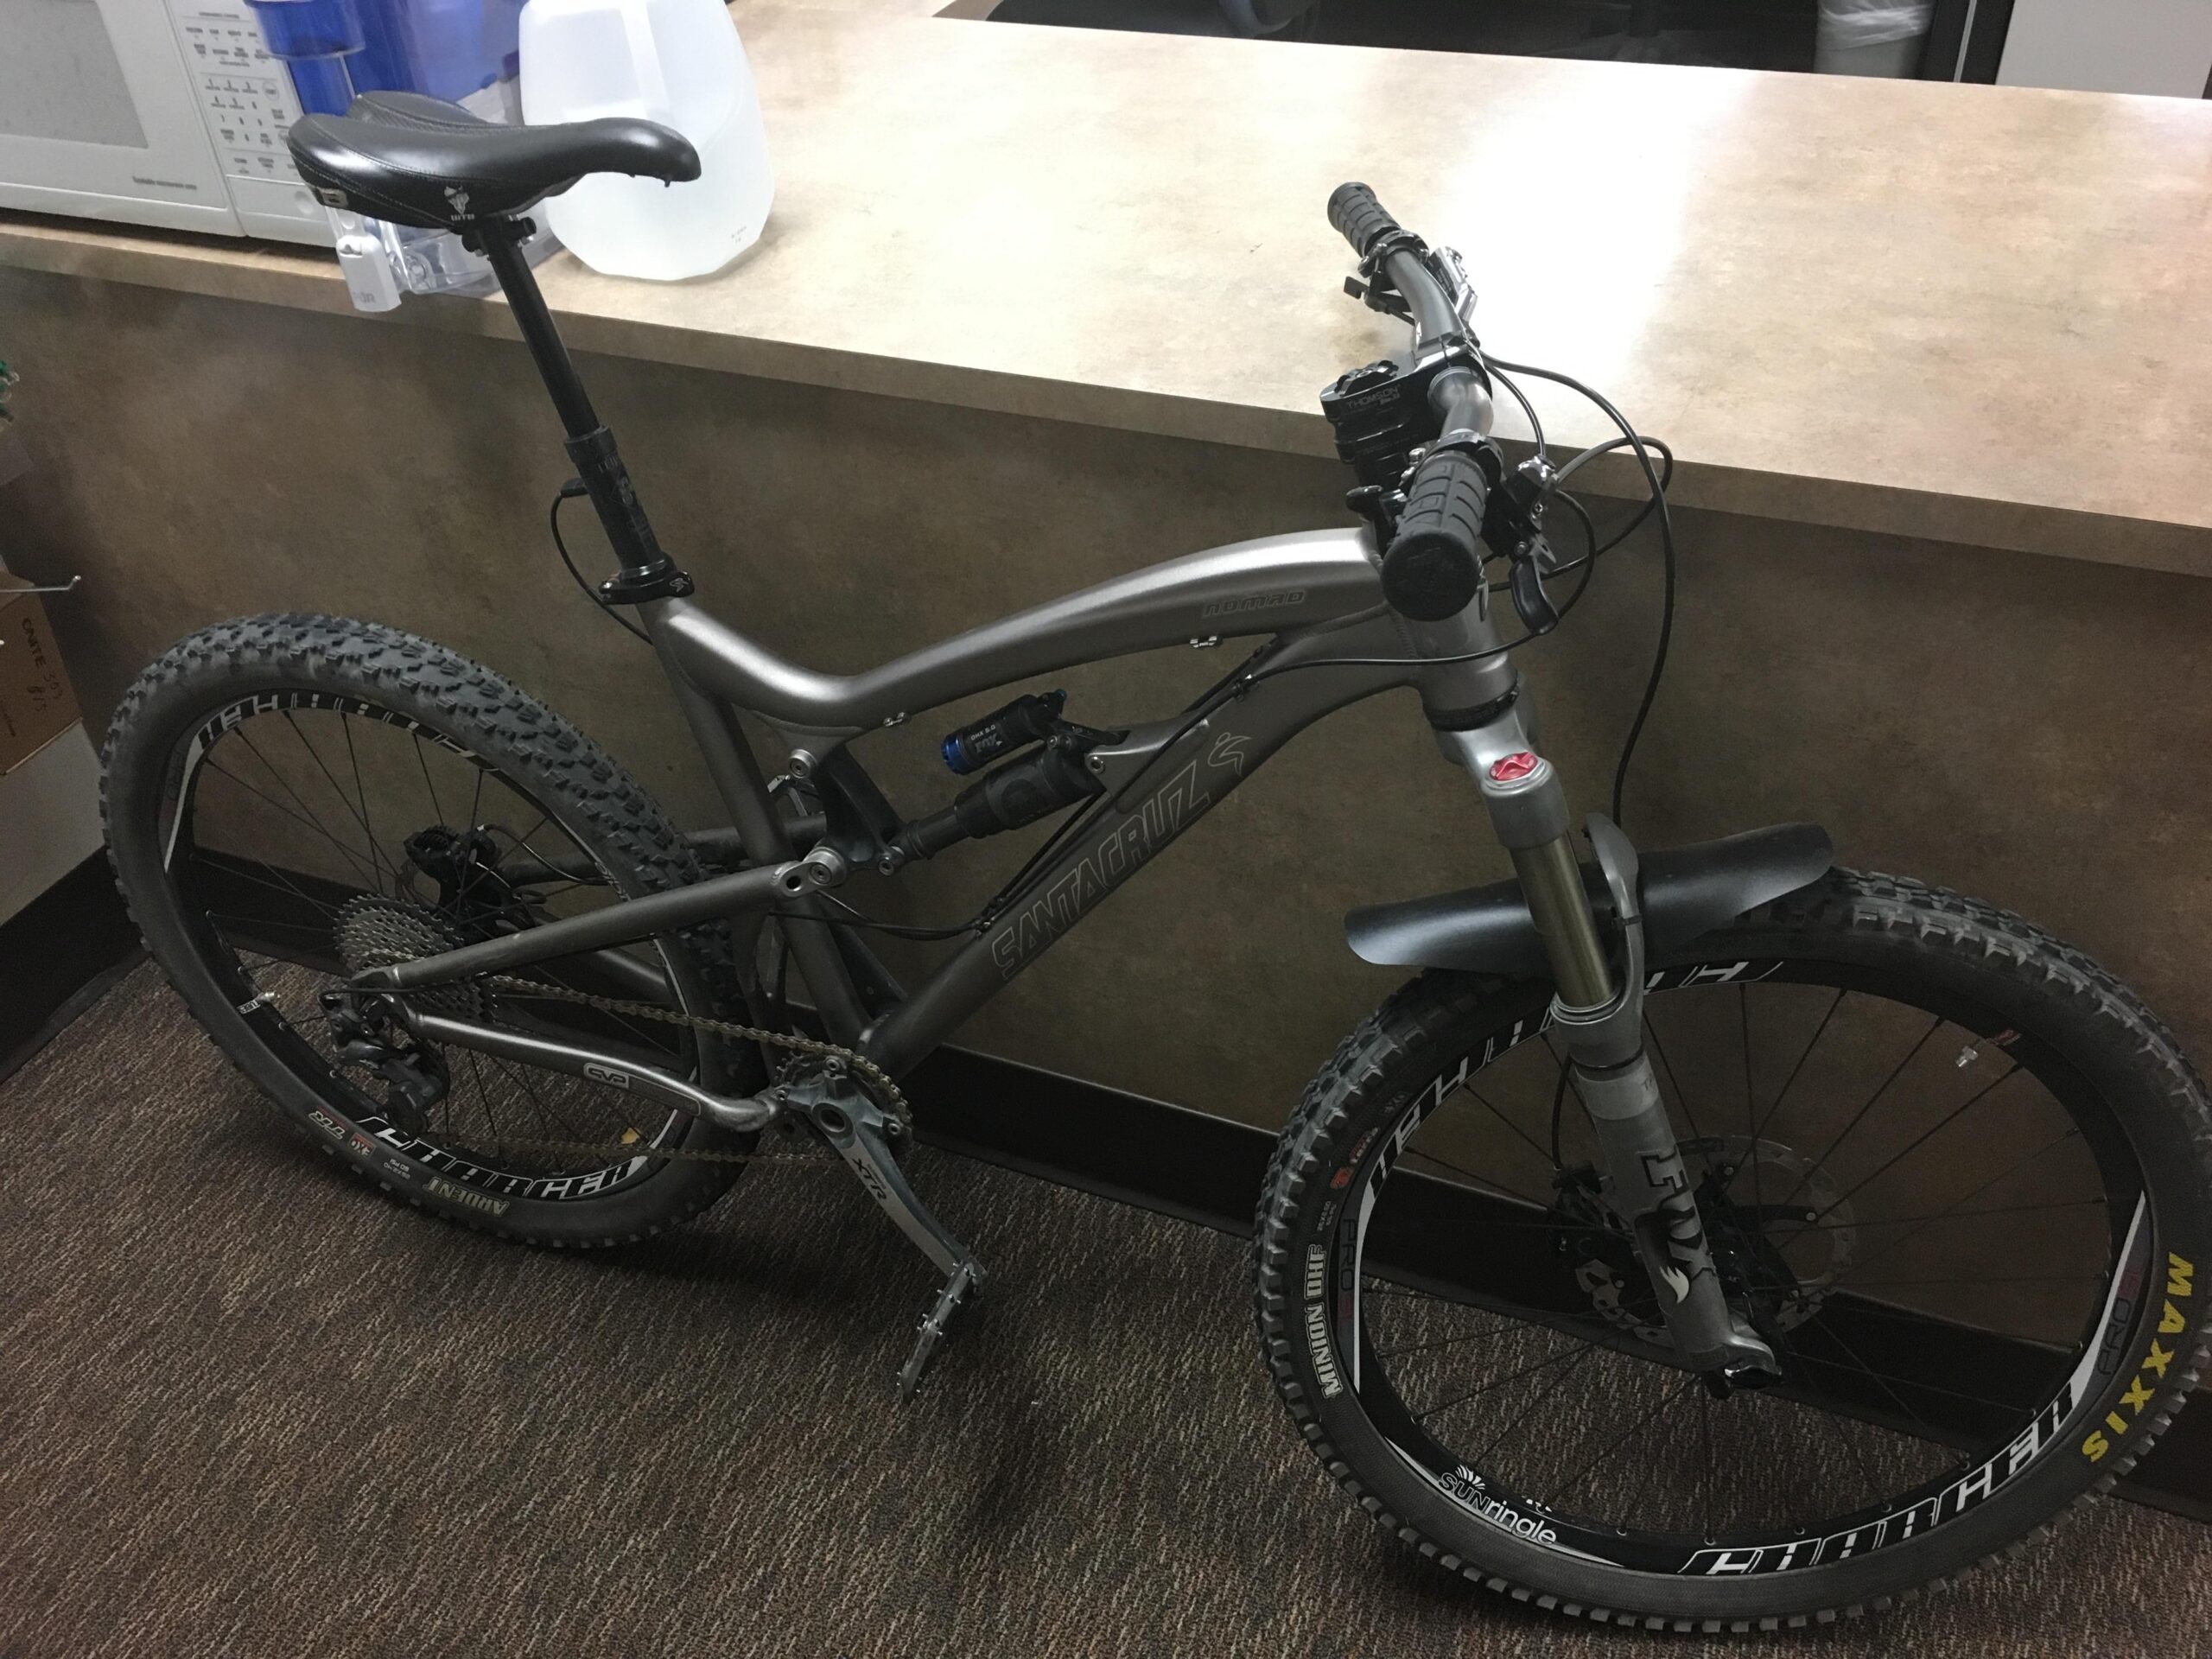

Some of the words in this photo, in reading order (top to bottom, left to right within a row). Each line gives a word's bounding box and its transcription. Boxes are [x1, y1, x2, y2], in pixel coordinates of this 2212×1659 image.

[1347, 385, 1399, 409] THOMSON
[423, 1175, 511, 1217] ARDENT
[851, 1158, 887, 1199] XTR
[1304, 1243, 1327, 1300] DHF
[1304, 1301, 1344, 1400] MINION
[2081, 1250, 2196, 1464] MAXXIS
